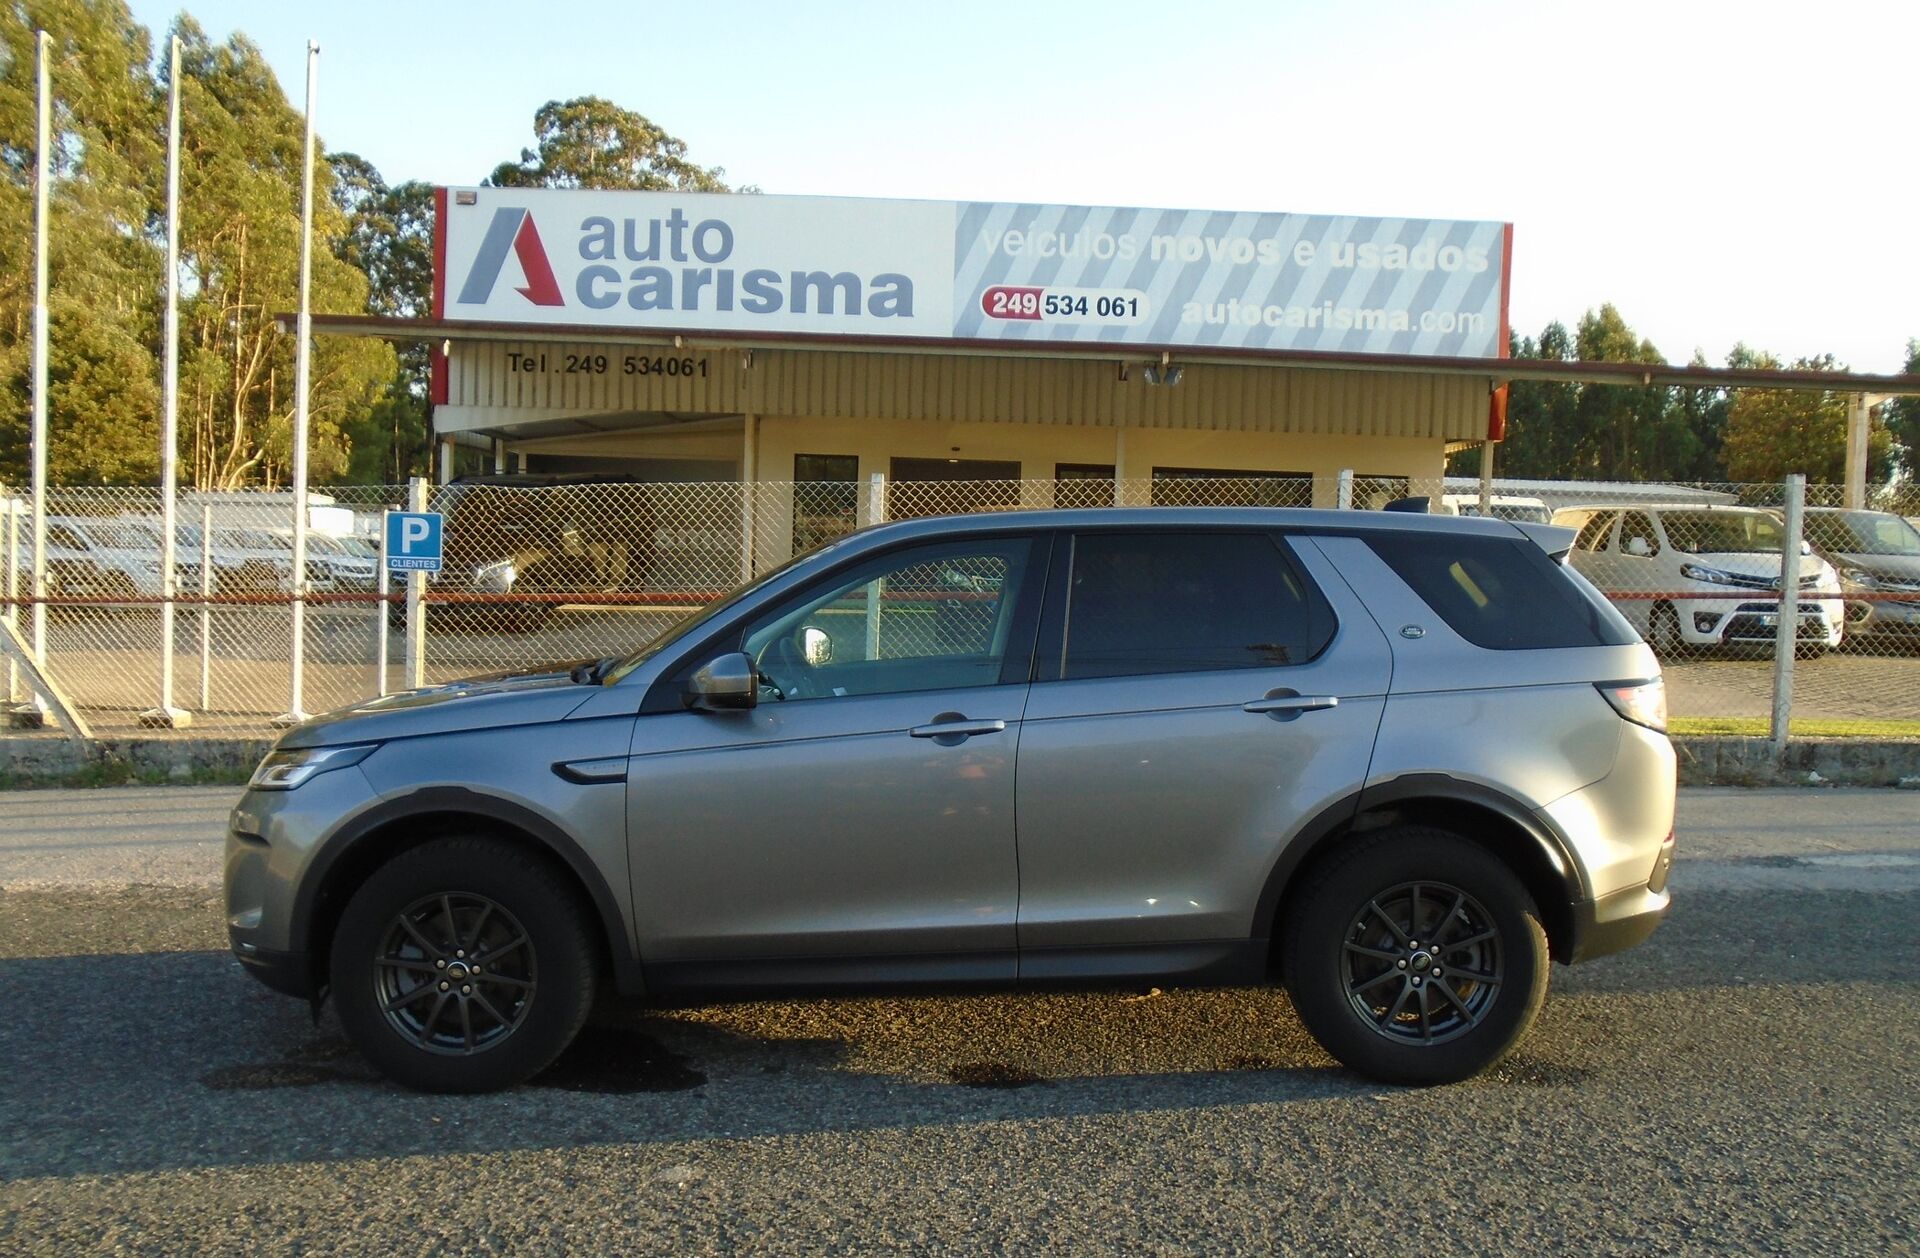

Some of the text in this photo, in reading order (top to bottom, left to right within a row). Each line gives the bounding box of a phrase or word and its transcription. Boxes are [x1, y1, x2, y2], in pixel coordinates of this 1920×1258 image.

[577, 208, 734, 264] auto
[982, 220, 1489, 273] veículos novos e usados
[576, 264, 914, 318] carisma
[992, 291, 1138, 317] 249 534 061
[1180, 297, 1486, 334] autocarisma.com
[623, 355, 708, 378] 534061
[402, 517, 430, 553] P
[390, 559, 437, 569] CLIENTES
